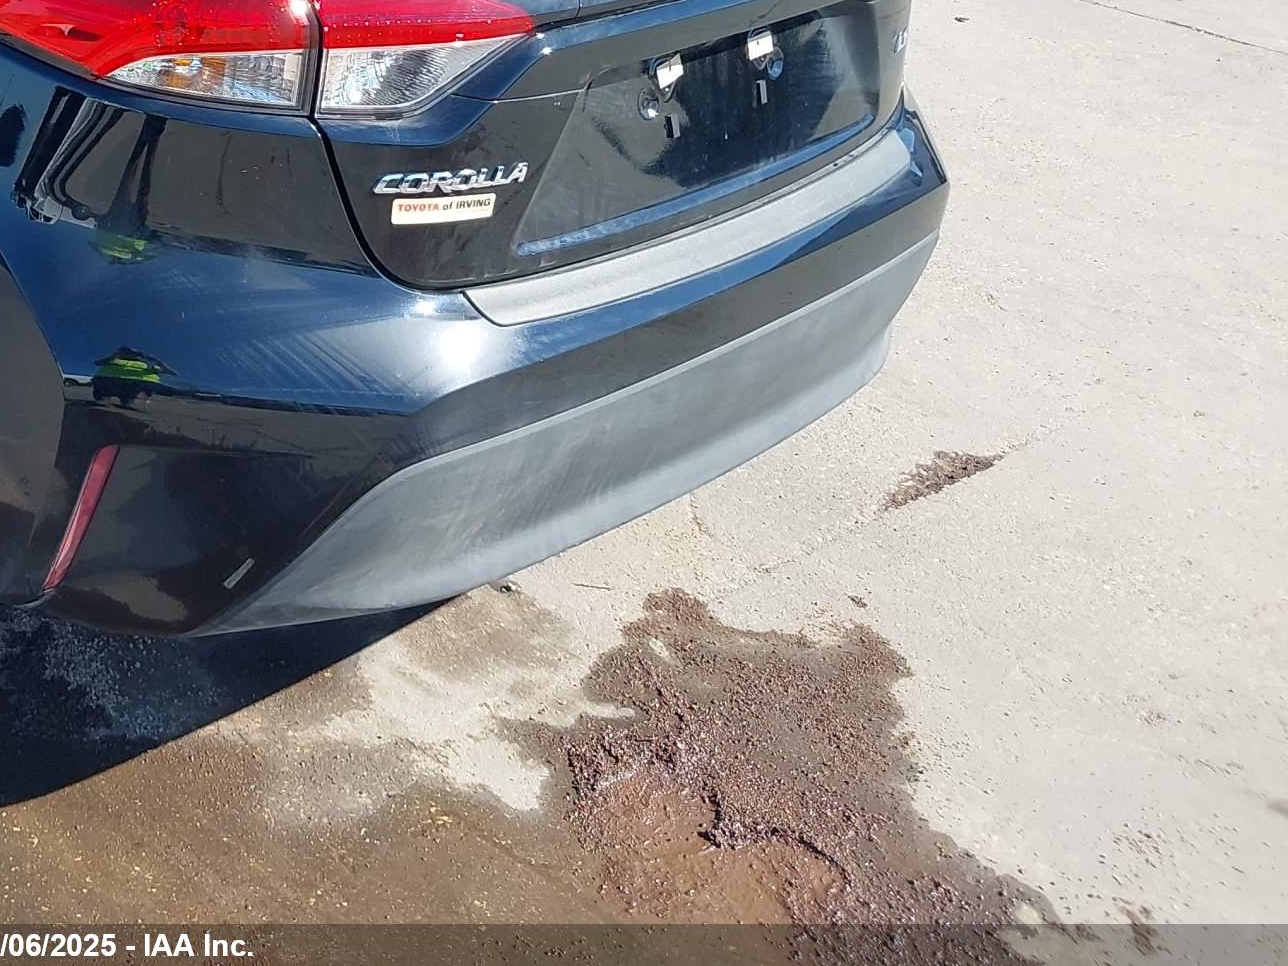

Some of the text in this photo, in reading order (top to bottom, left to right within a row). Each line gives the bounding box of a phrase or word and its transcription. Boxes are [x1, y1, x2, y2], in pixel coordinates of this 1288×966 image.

[373, 162, 529, 194] COROLLA
[397, 198, 491, 213] TOYOTA of IRVING
